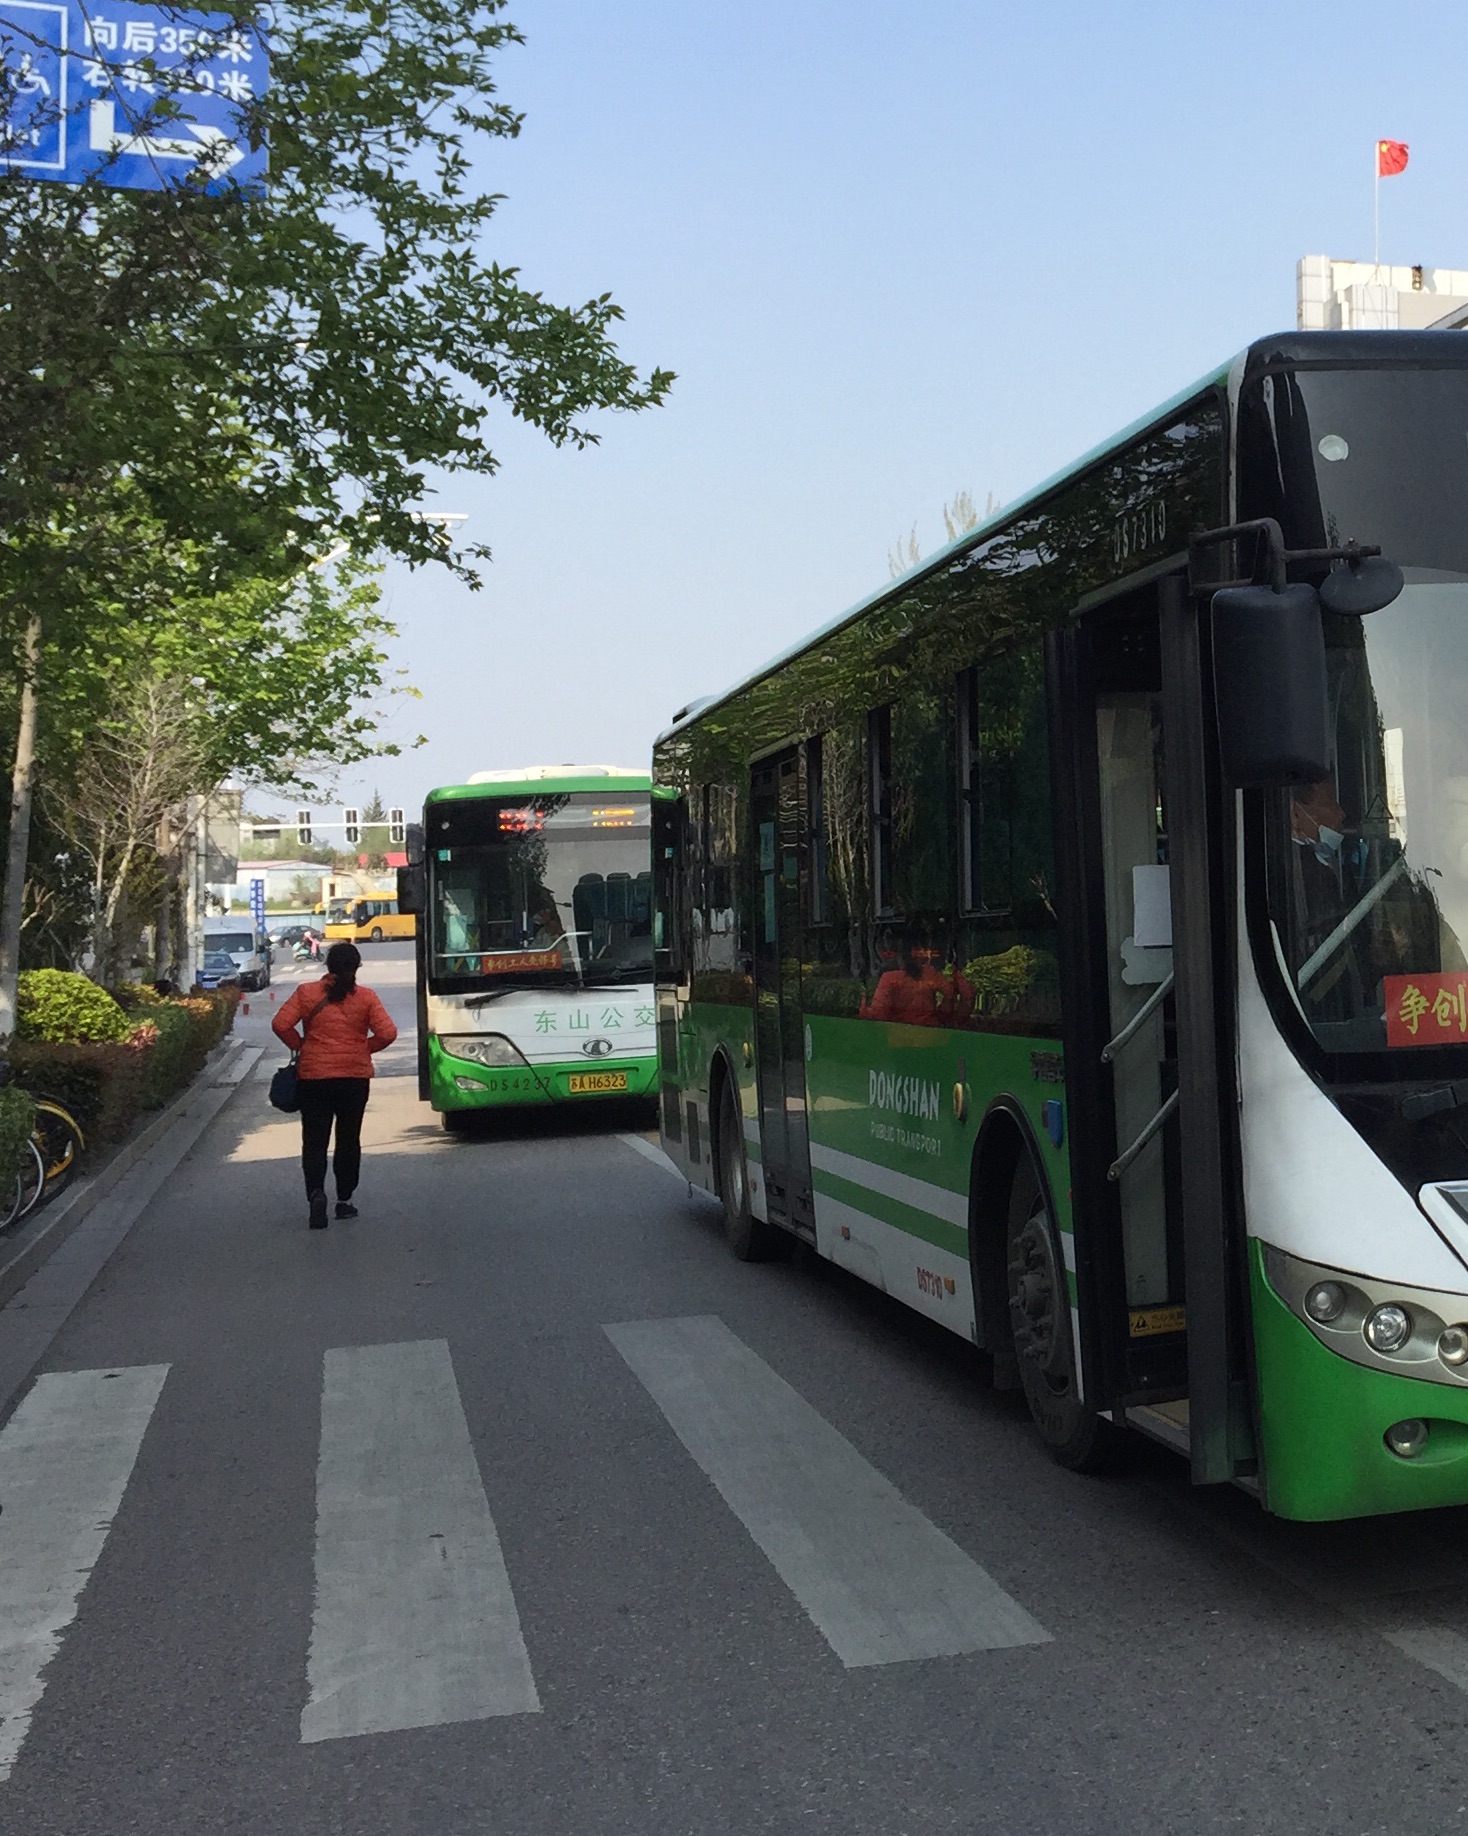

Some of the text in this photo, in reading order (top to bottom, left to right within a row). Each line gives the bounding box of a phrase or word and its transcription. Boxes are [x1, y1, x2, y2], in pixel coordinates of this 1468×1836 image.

[534, 1006, 655, 1034] 东山公交
[869, 1069, 941, 1121] DONGSHAN
[897, 1128, 941, 1157] TRANSPORT
